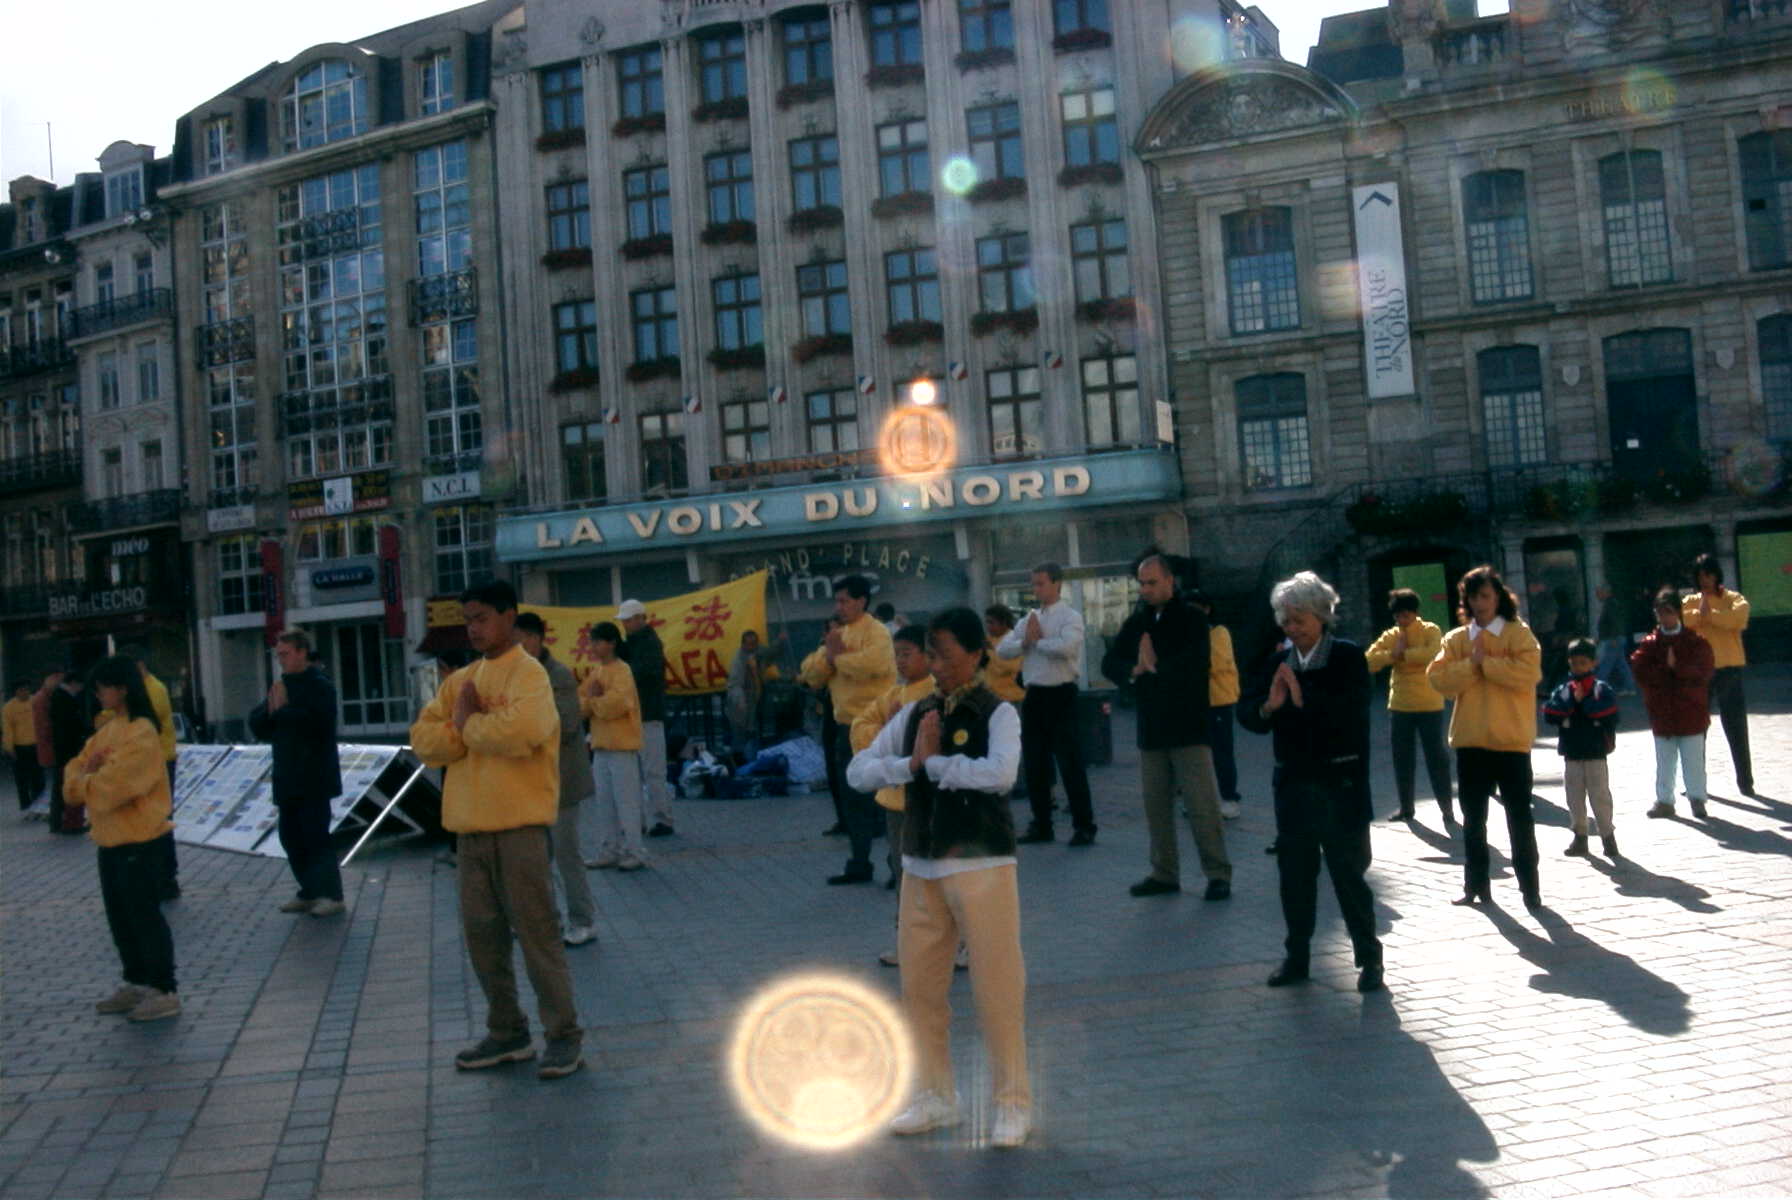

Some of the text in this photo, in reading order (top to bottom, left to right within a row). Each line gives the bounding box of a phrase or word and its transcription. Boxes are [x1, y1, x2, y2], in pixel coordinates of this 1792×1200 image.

[1387, 288, 1408, 356] NORD
[536, 466, 1092, 549] LA VOIX DU NORD
[843, 543, 929, 580] PLACE
[48, 594, 79, 616] BAR
[786, 571, 880, 602] fnc
